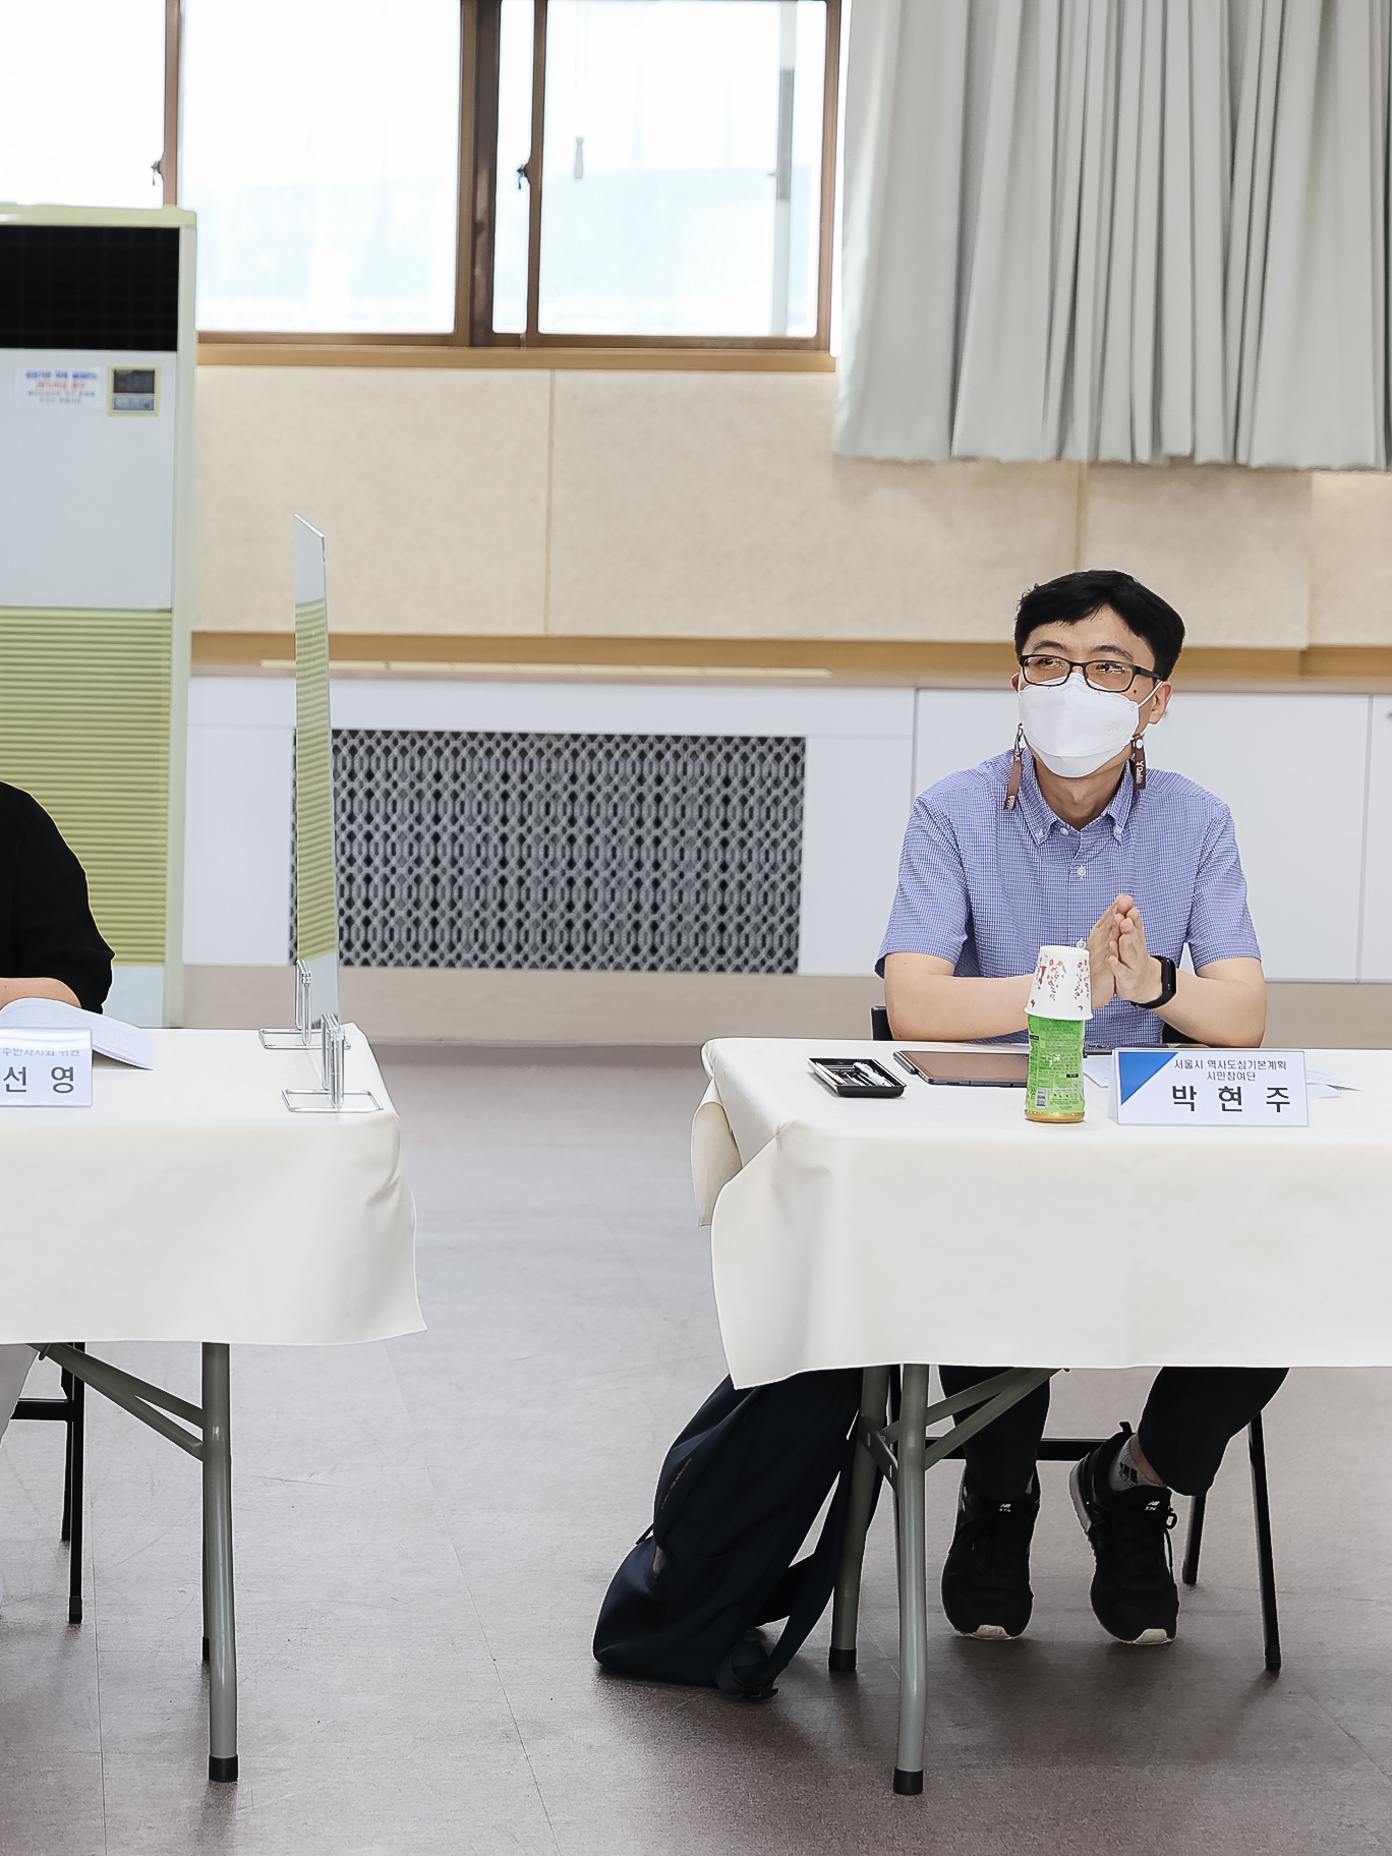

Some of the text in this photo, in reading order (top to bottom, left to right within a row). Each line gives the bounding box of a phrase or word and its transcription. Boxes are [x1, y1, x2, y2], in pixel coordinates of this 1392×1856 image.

[1174, 1059, 1287, 1071] 서울시 역사도심기본계획
[1206, 1071, 1257, 1081] 시민참여단
